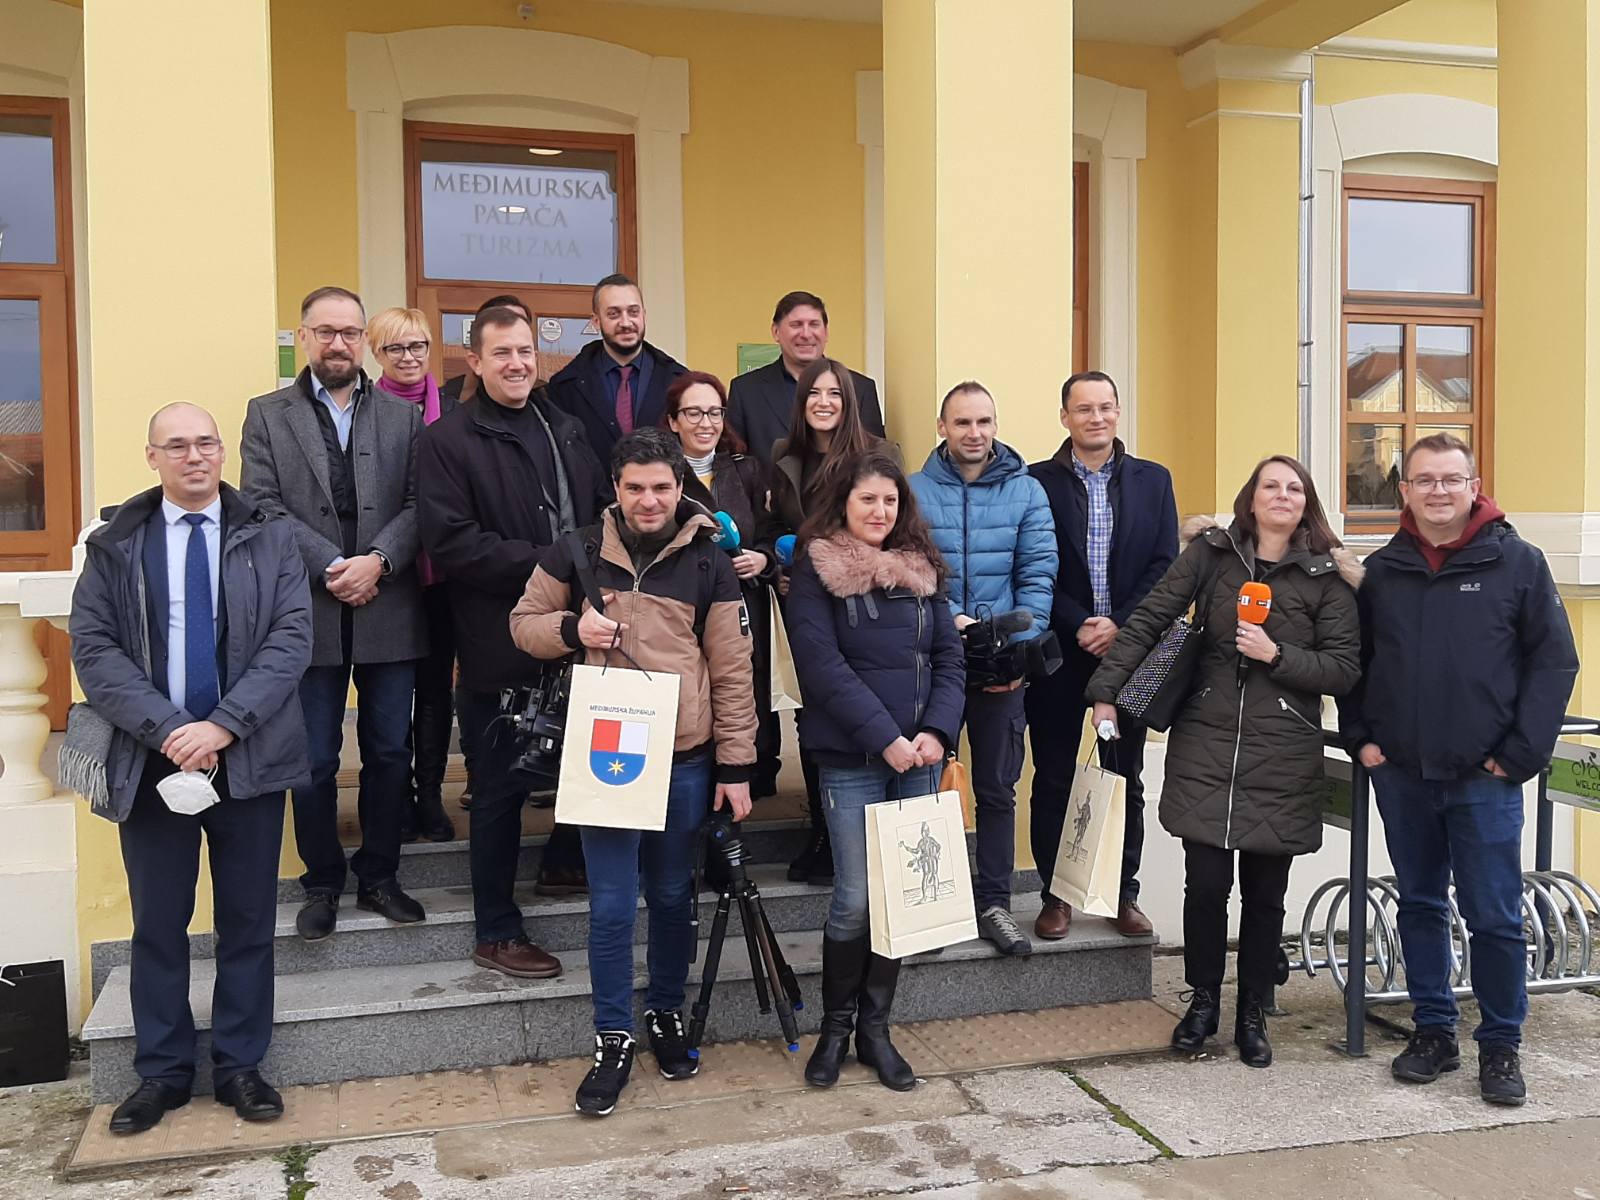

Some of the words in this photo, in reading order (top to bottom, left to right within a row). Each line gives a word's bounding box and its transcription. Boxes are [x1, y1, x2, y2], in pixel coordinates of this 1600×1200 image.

[434, 172, 606, 200] MEĐIMURSKA
[474, 202, 568, 228] PALAČA
[460, 233, 582, 259] TURIZMA
